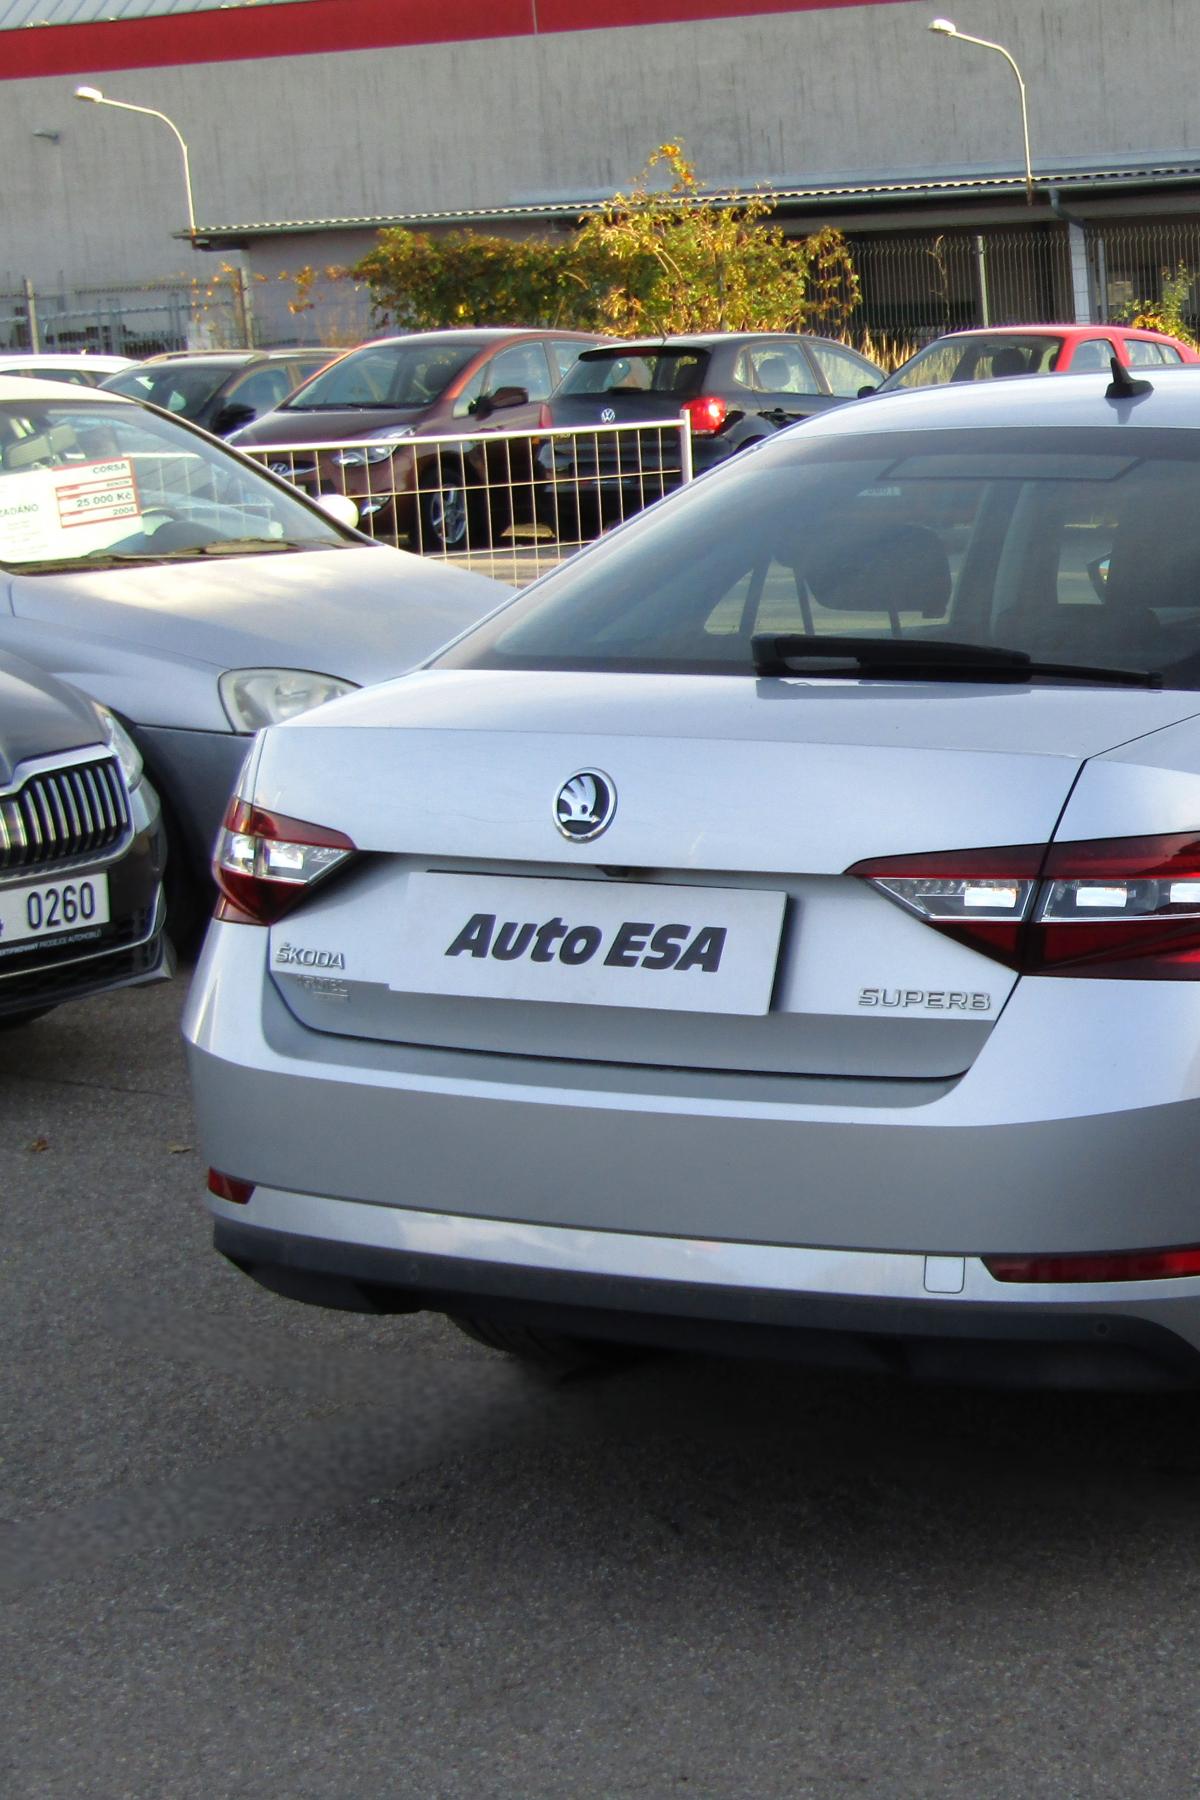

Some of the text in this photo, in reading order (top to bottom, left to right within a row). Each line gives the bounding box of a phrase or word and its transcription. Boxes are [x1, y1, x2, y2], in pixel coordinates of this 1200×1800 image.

[93, 463, 127, 474] CORSA
[76, 491, 131, 507] 25 000 Kč
[27, 882, 95, 930] 0260
[444, 913, 727, 972] Auto ESA
[276, 942, 345, 970] ŠKODA
[858, 988, 991, 1011] SUPERB
